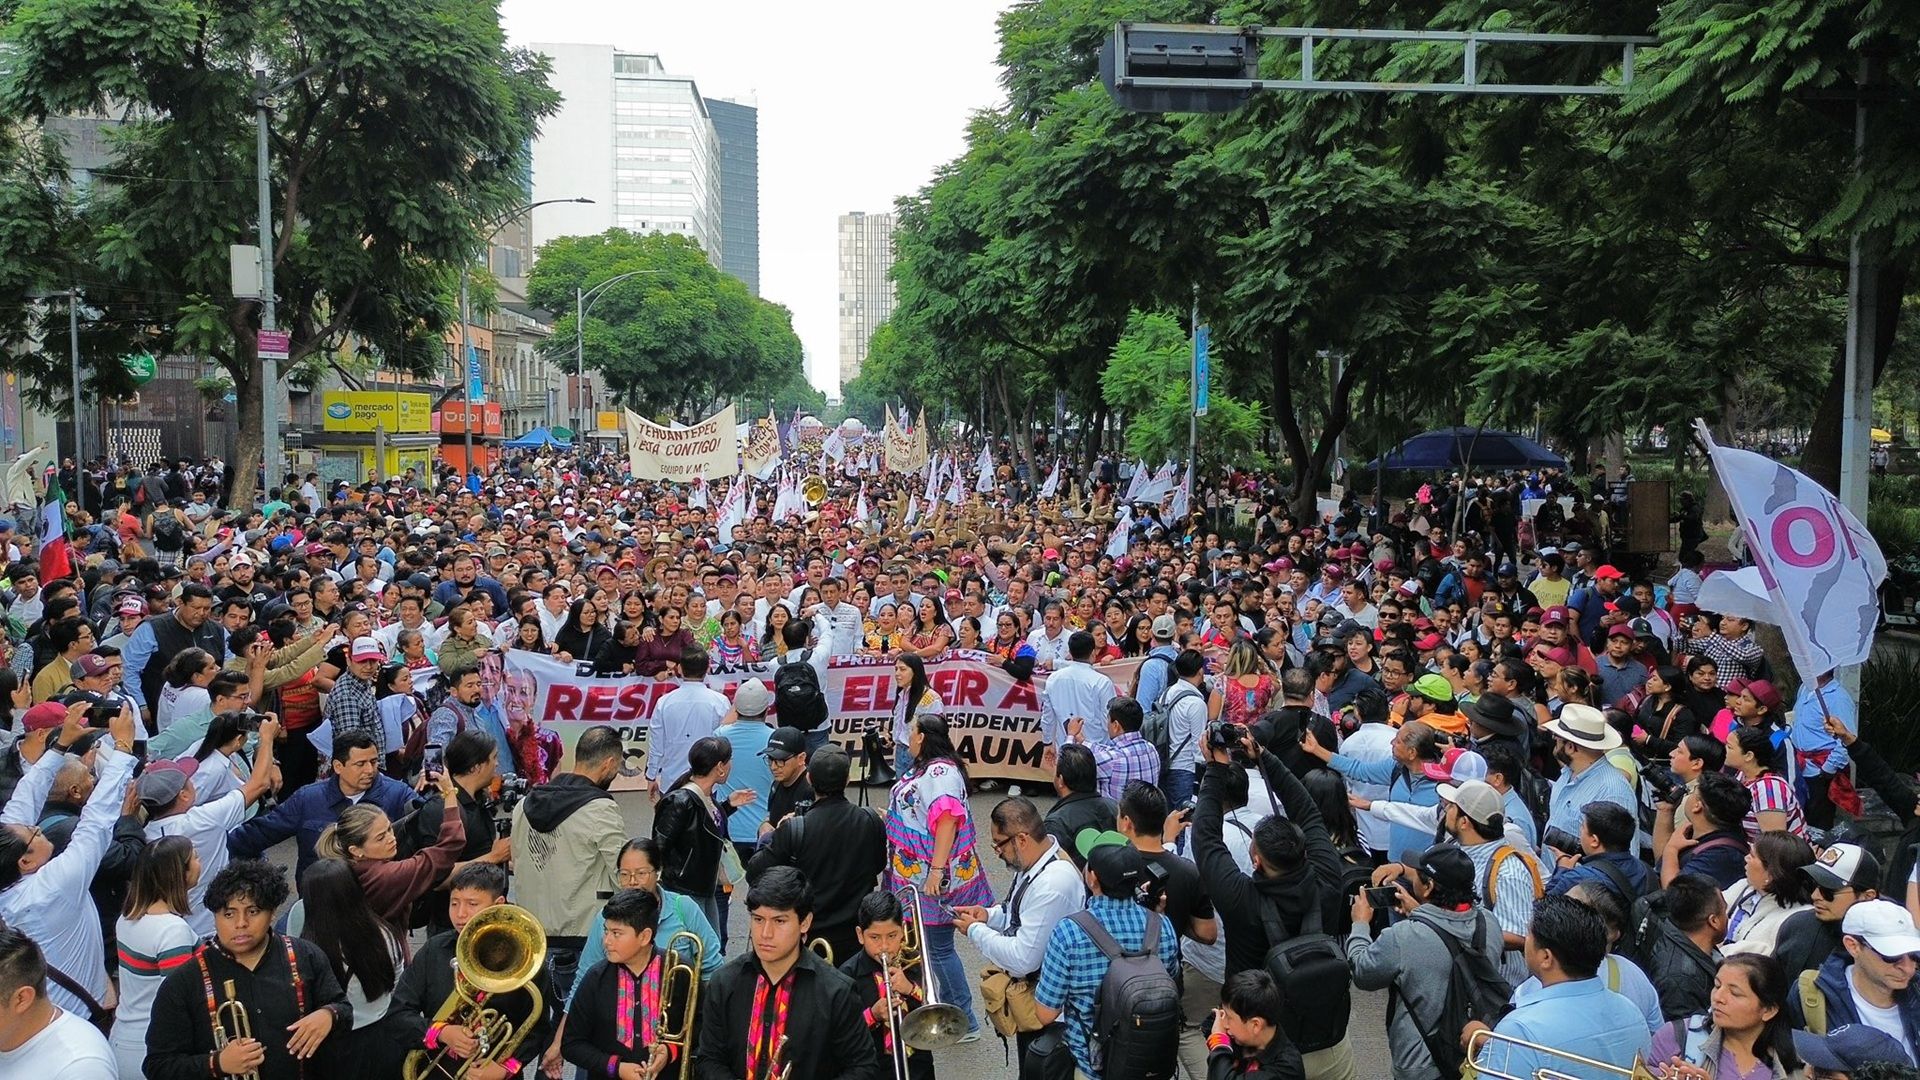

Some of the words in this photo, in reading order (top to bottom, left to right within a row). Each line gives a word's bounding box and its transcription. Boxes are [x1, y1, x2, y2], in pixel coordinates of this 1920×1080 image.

[354, 411, 377, 419] pago
[459, 413, 479, 422] DDi
[639, 422, 717, 440] TEHUANTEPEC
[666, 438, 721, 456] CONTIGO!
[660, 465, 683, 474] EQUIPO
